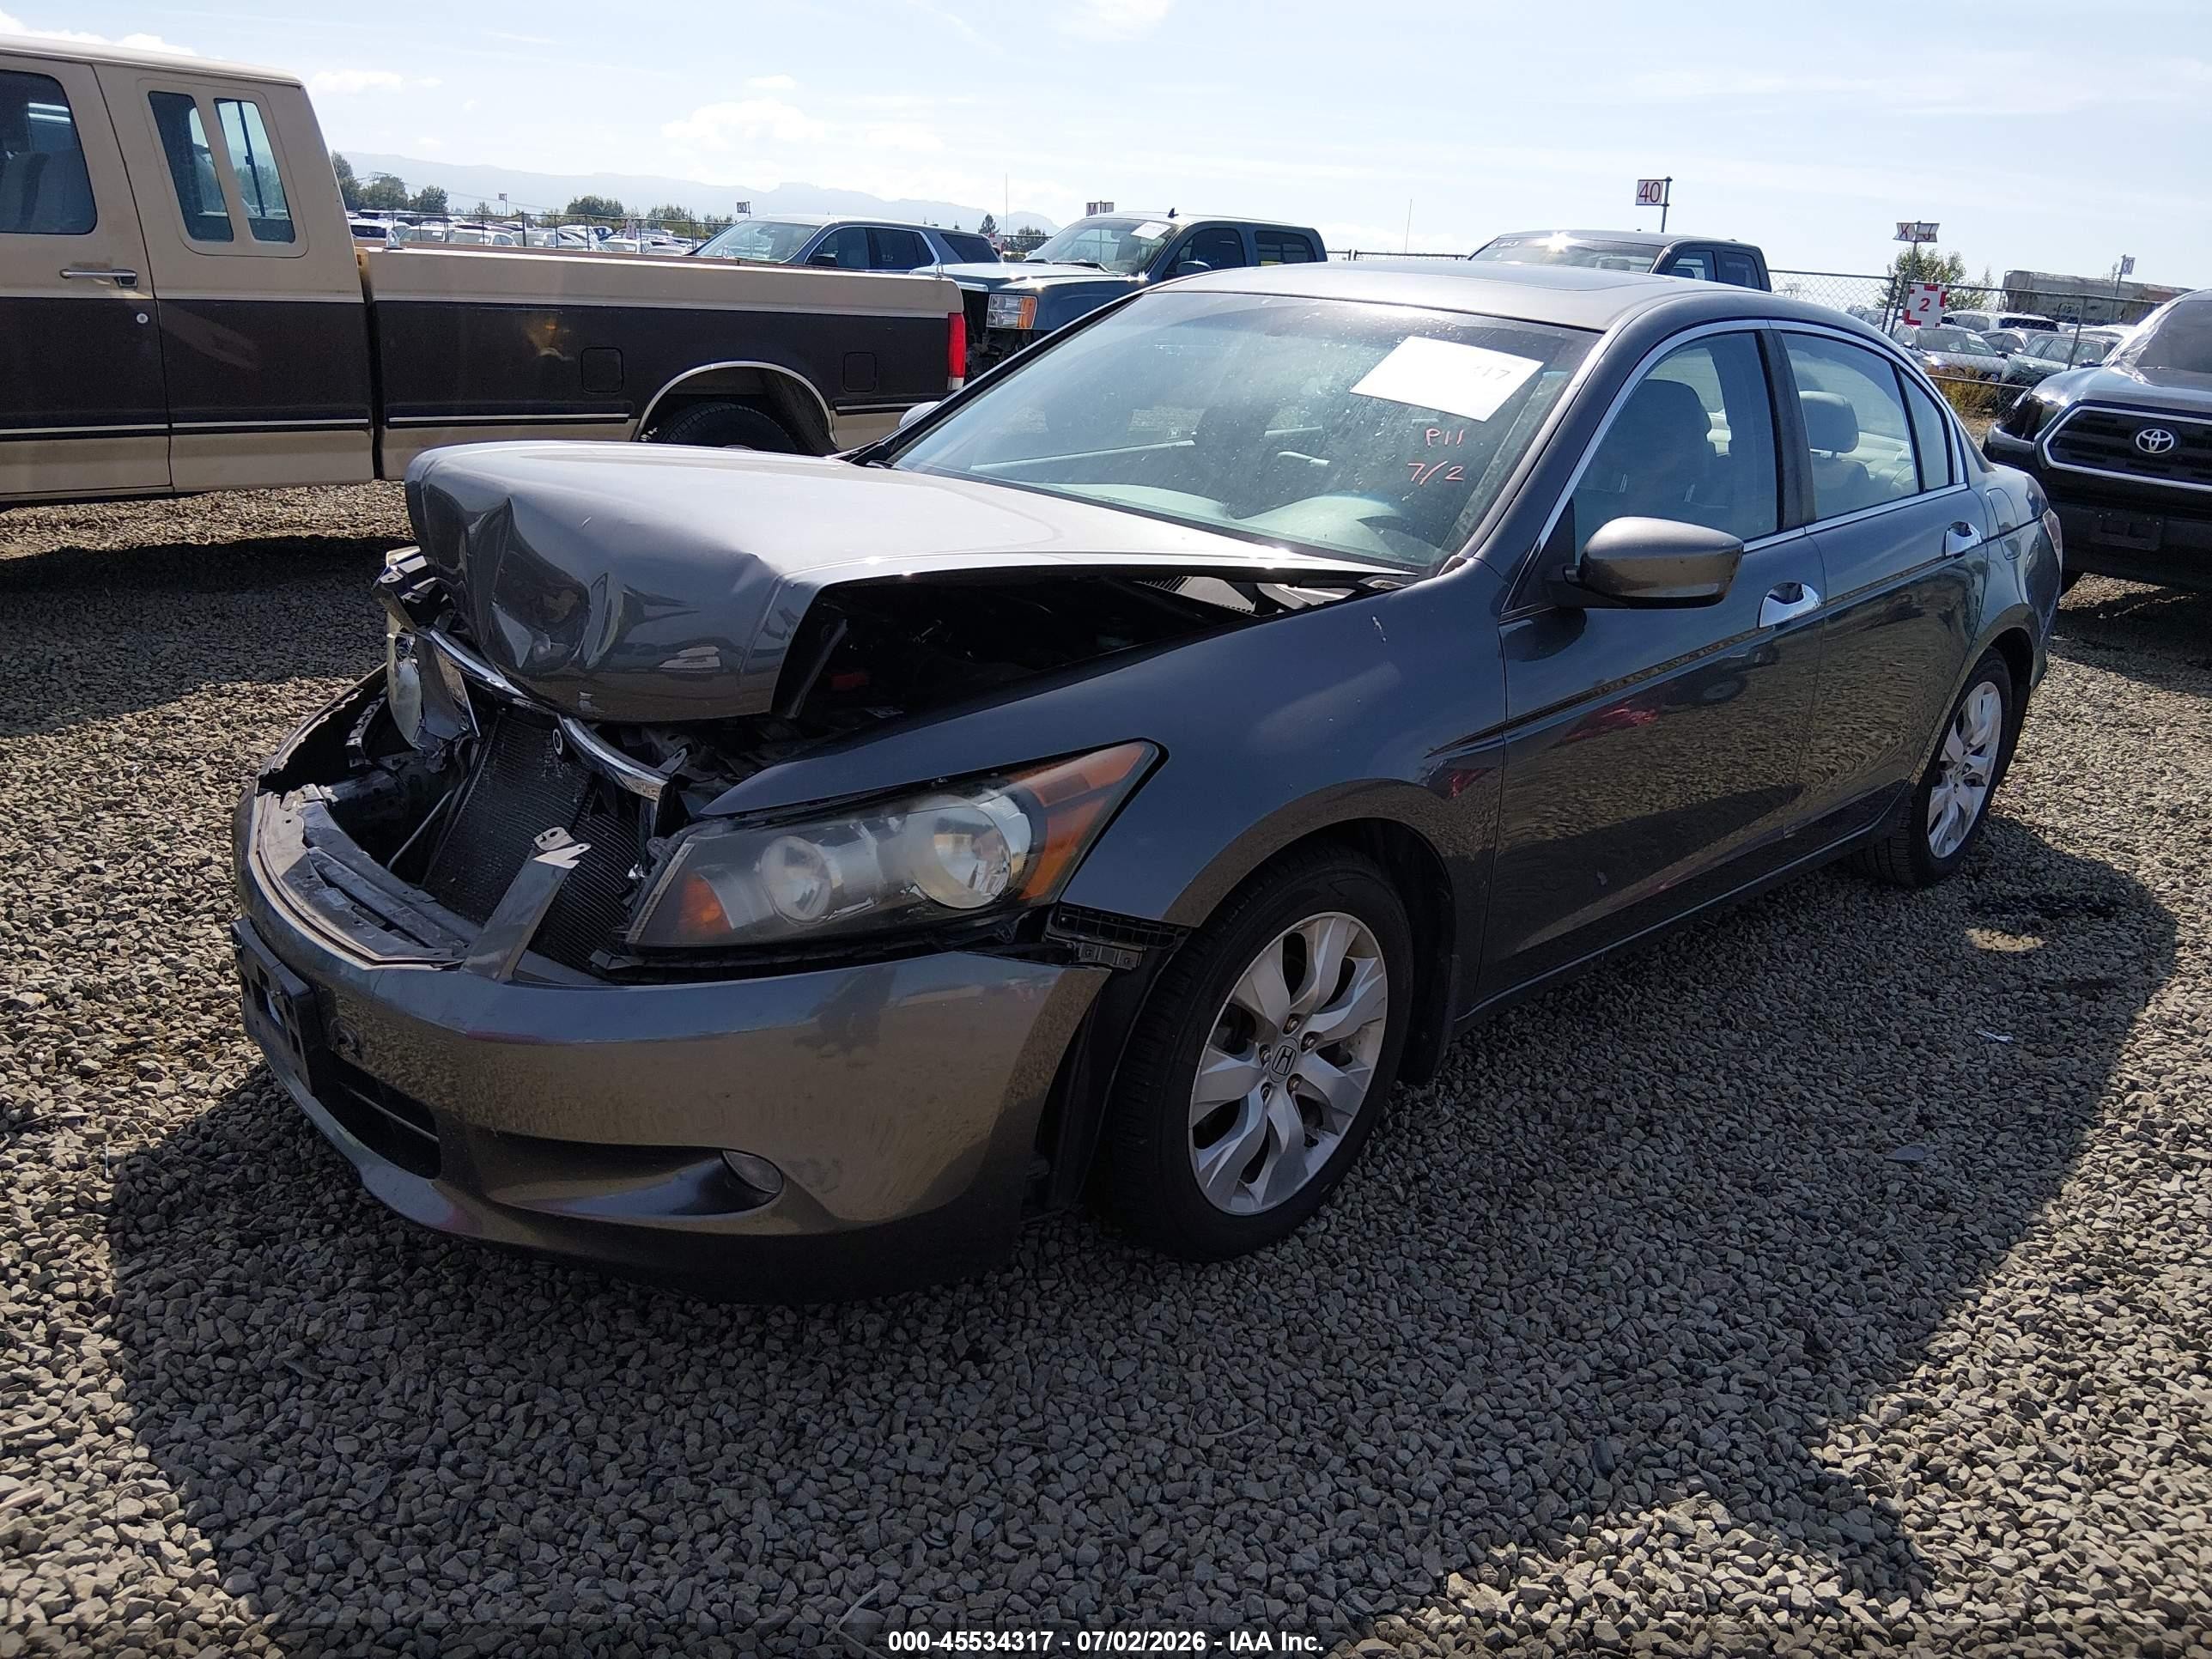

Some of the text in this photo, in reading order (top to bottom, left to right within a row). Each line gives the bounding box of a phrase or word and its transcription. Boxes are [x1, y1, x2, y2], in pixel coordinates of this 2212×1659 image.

[1638, 181, 1661, 203] 40
[1919, 297, 1930, 312] 2
[1407, 460, 1464, 486] 7/2
